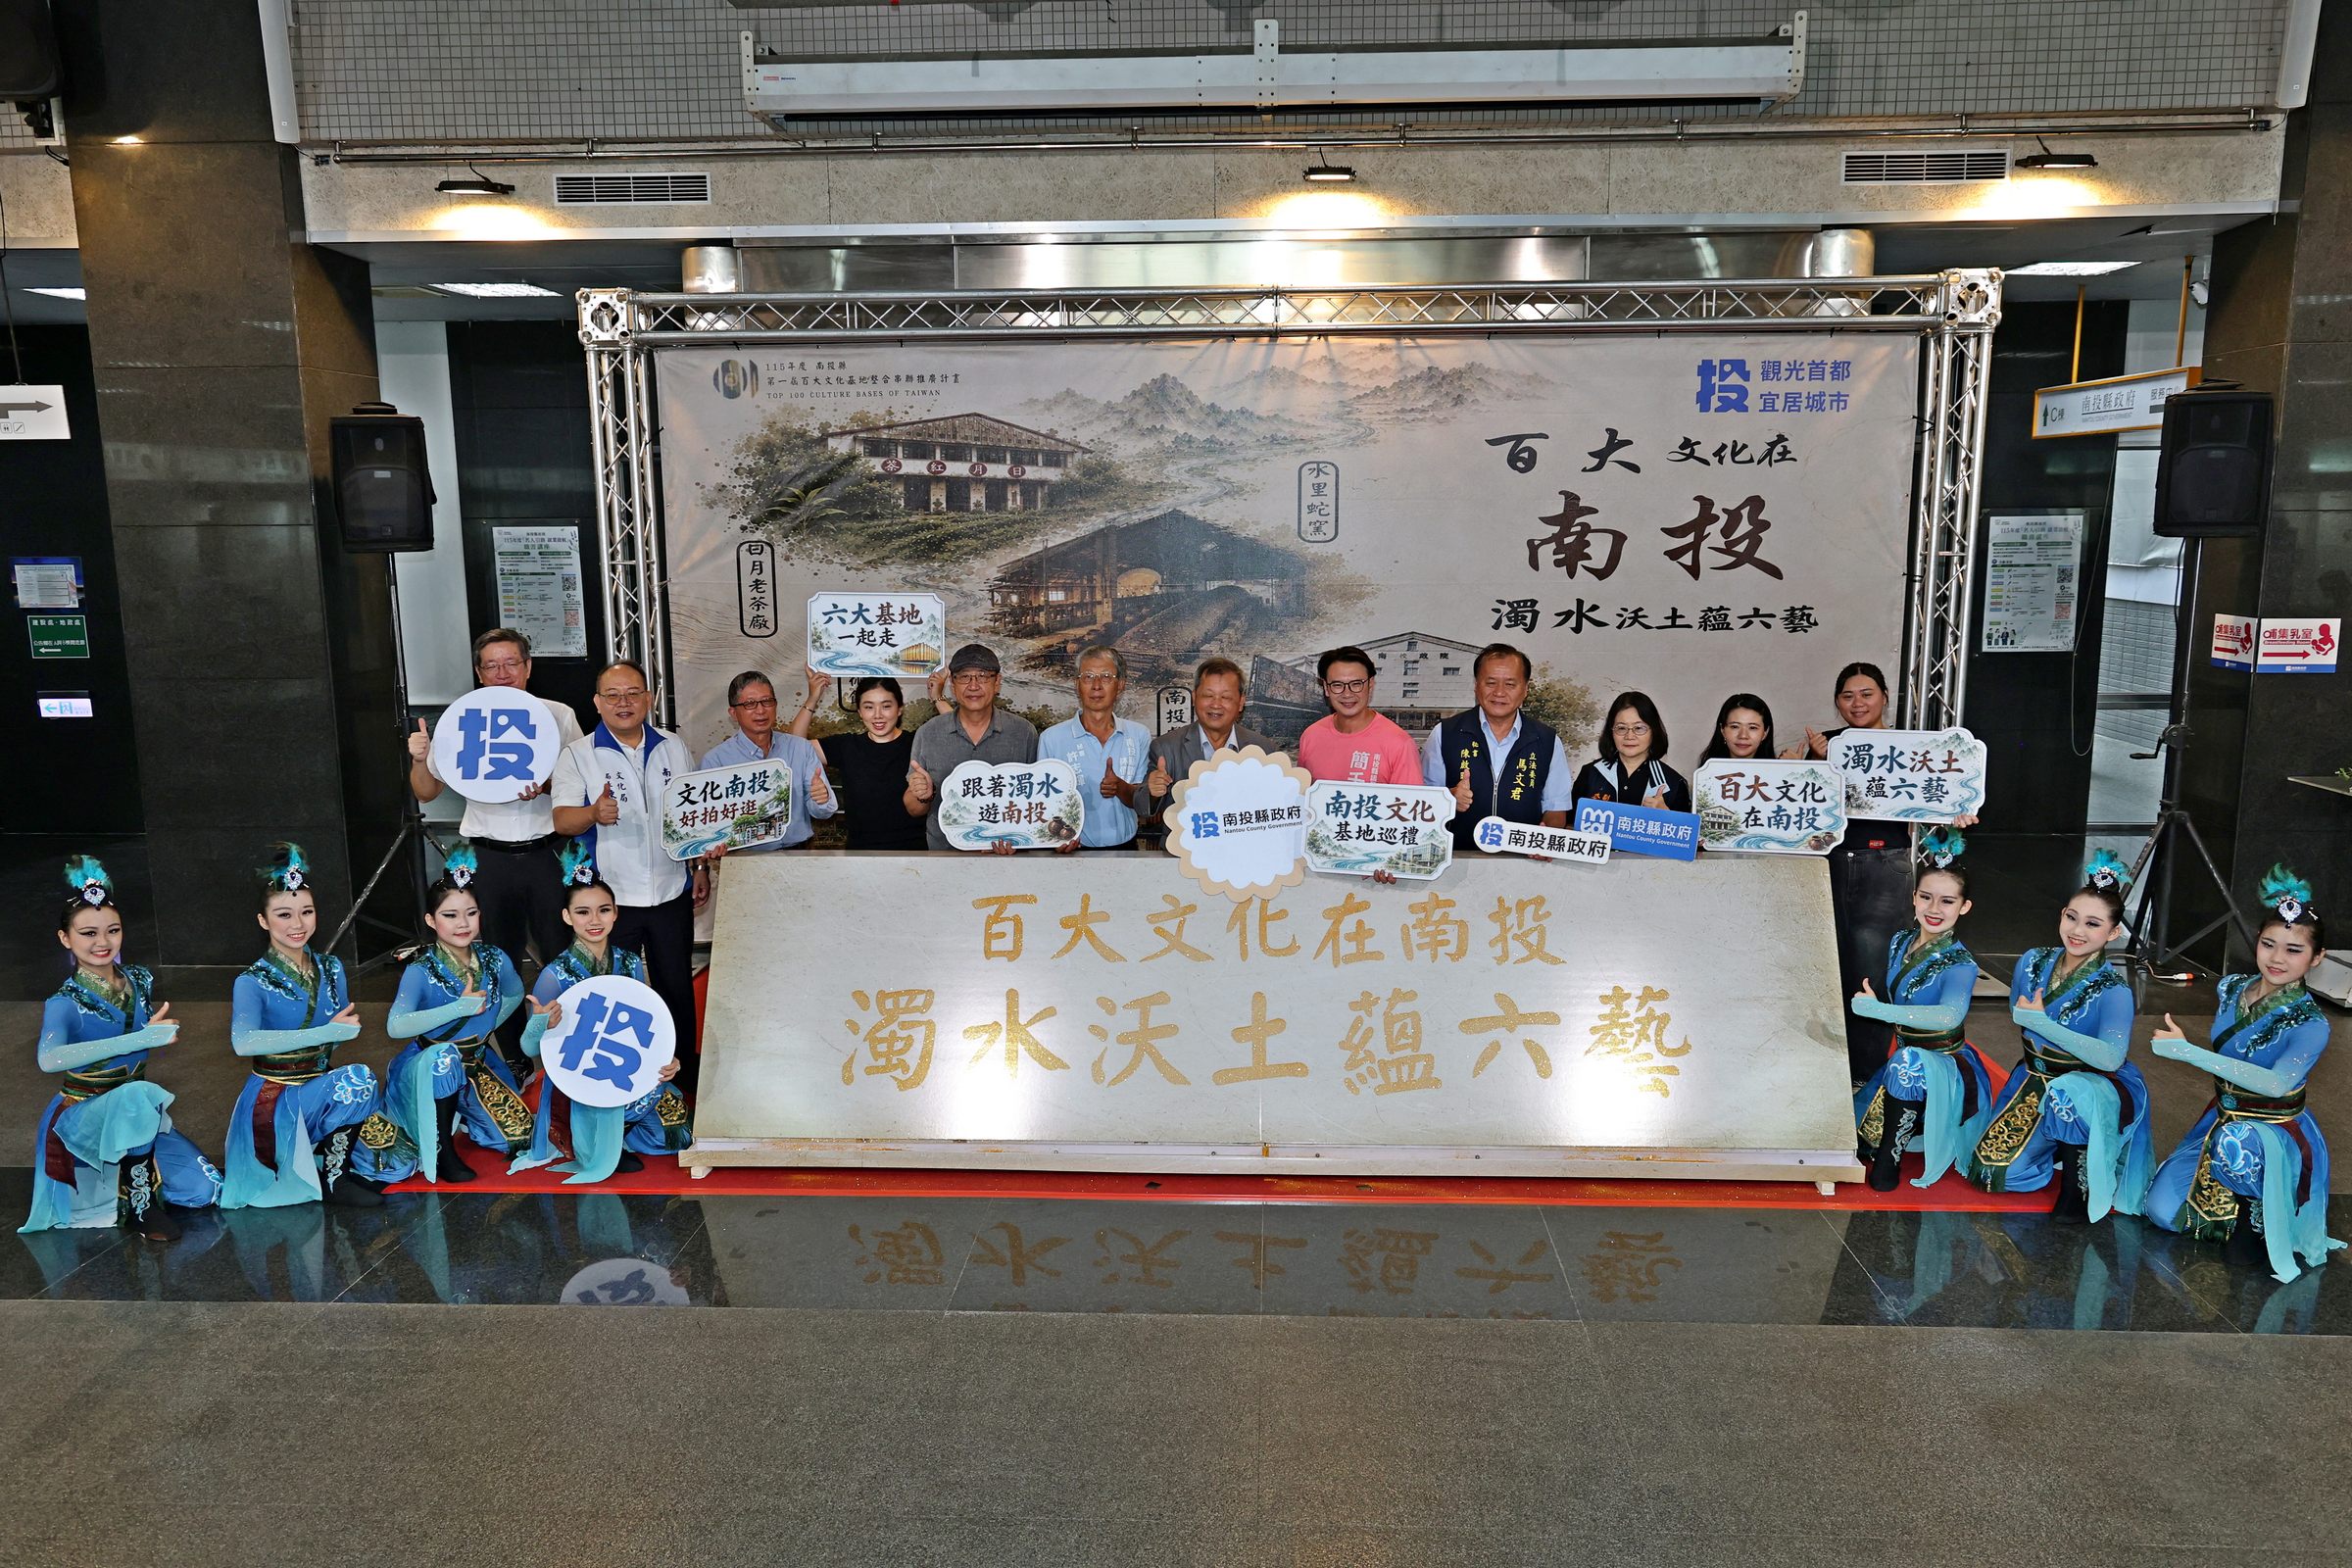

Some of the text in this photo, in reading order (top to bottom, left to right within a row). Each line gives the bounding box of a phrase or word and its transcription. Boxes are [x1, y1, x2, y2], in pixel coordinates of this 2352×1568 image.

[766, 362, 808, 371] 115年度
[1760, 360, 1851, 382] 觀光首都
[1695, 359, 1750, 413] 投
[2082, 389, 2136, 413] 南投縣政府
[1758, 391, 1850, 413] 宜居城市
[1527, 490, 1784, 581] 南投
[748, 544, 770, 630] 日月老茶廠
[822, 602, 923, 626] 六大基地
[1491, 598, 1819, 635] 濁水沃土蘊六藝
[838, 627, 900, 648] 一起走
[2263, 628, 2313, 639] 哺集乳室
[1165, 690, 1187, 732] 南投
[456, 709, 537, 780] 投
[1841, 743, 1964, 774] 濁水沃土
[961, 772, 1063, 799] 跟著濁水
[1510, 759, 1528, 801] 馬文君
[1529, 752, 1538, 789] 立法委員
[616, 771, 628, 803] 文化局
[675, 770, 771, 808] 文化南投
[1715, 772, 1827, 803] 百大文化
[1865, 776, 1949, 804] 蘊六藝
[679, 800, 759, 828] 好拍好逛
[978, 801, 1049, 824] 遊南投
[1325, 790, 1436, 822] 南投文化
[1741, 805, 1823, 831] 在南投
[1191, 806, 1301, 839] 投 南投縣政府
[1333, 821, 1419, 846] 基地巡禮
[1617, 816, 1692, 841] 南投縣政府
[1479, 822, 1608, 858] 投 南投縣政府
[1636, 834, 1656, 845] County
[1656, 838, 1690, 849] Government
[971, 892, 1568, 967] 百大文化在南投
[559, 992, 655, 1092] 投
[841, 985, 1692, 1098] 濁水沃土蘊六藝
